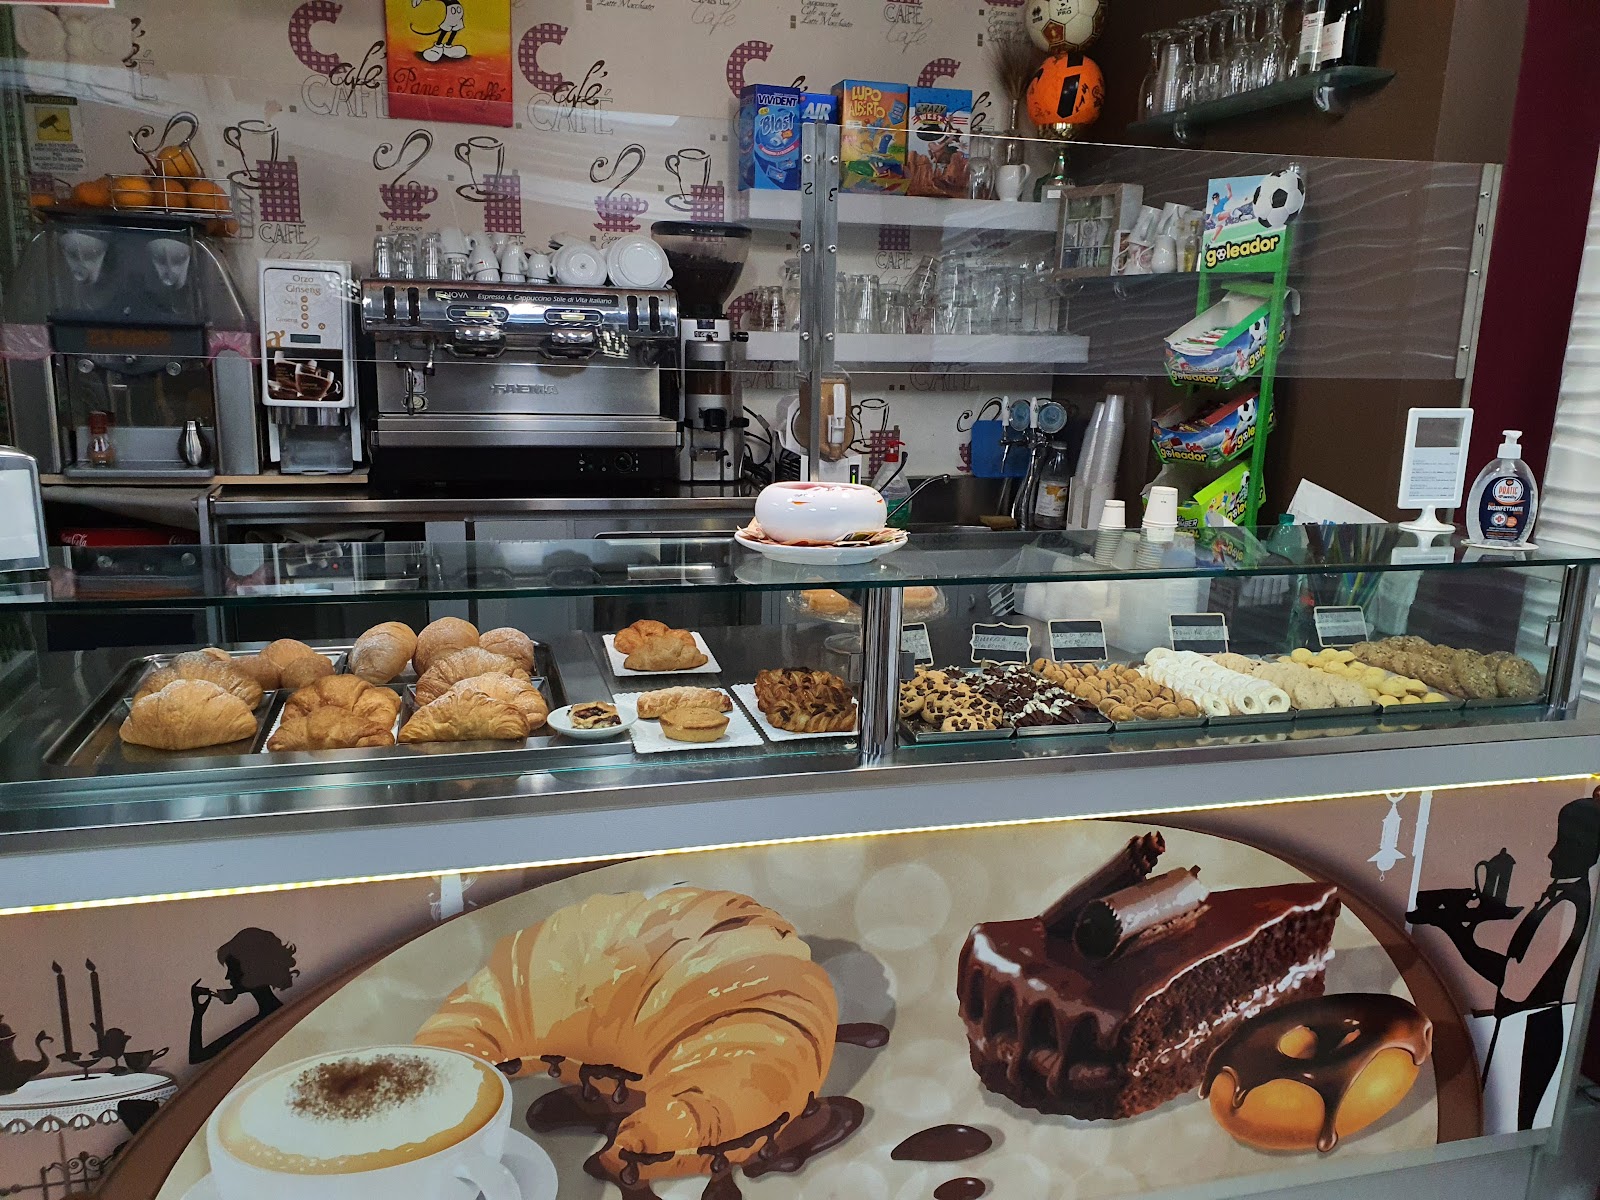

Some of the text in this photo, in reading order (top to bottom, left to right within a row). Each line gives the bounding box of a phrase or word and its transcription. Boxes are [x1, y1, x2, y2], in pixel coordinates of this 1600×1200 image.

[394, 66, 440, 96] Pane
[851, 85, 882, 102] LUPO
[801, 102, 833, 120] AIR
[1205, 234, 1280, 268] goleador
[292, 274, 314, 283] Orzo
[286, 284, 321, 296] Ginseng
[477, 293, 506, 302] Espresso
[513, 294, 552, 304] Cappuccino
[1160, 448, 1207, 462] goleador
[1487, 504, 1524, 512] DISINFETTANTE
